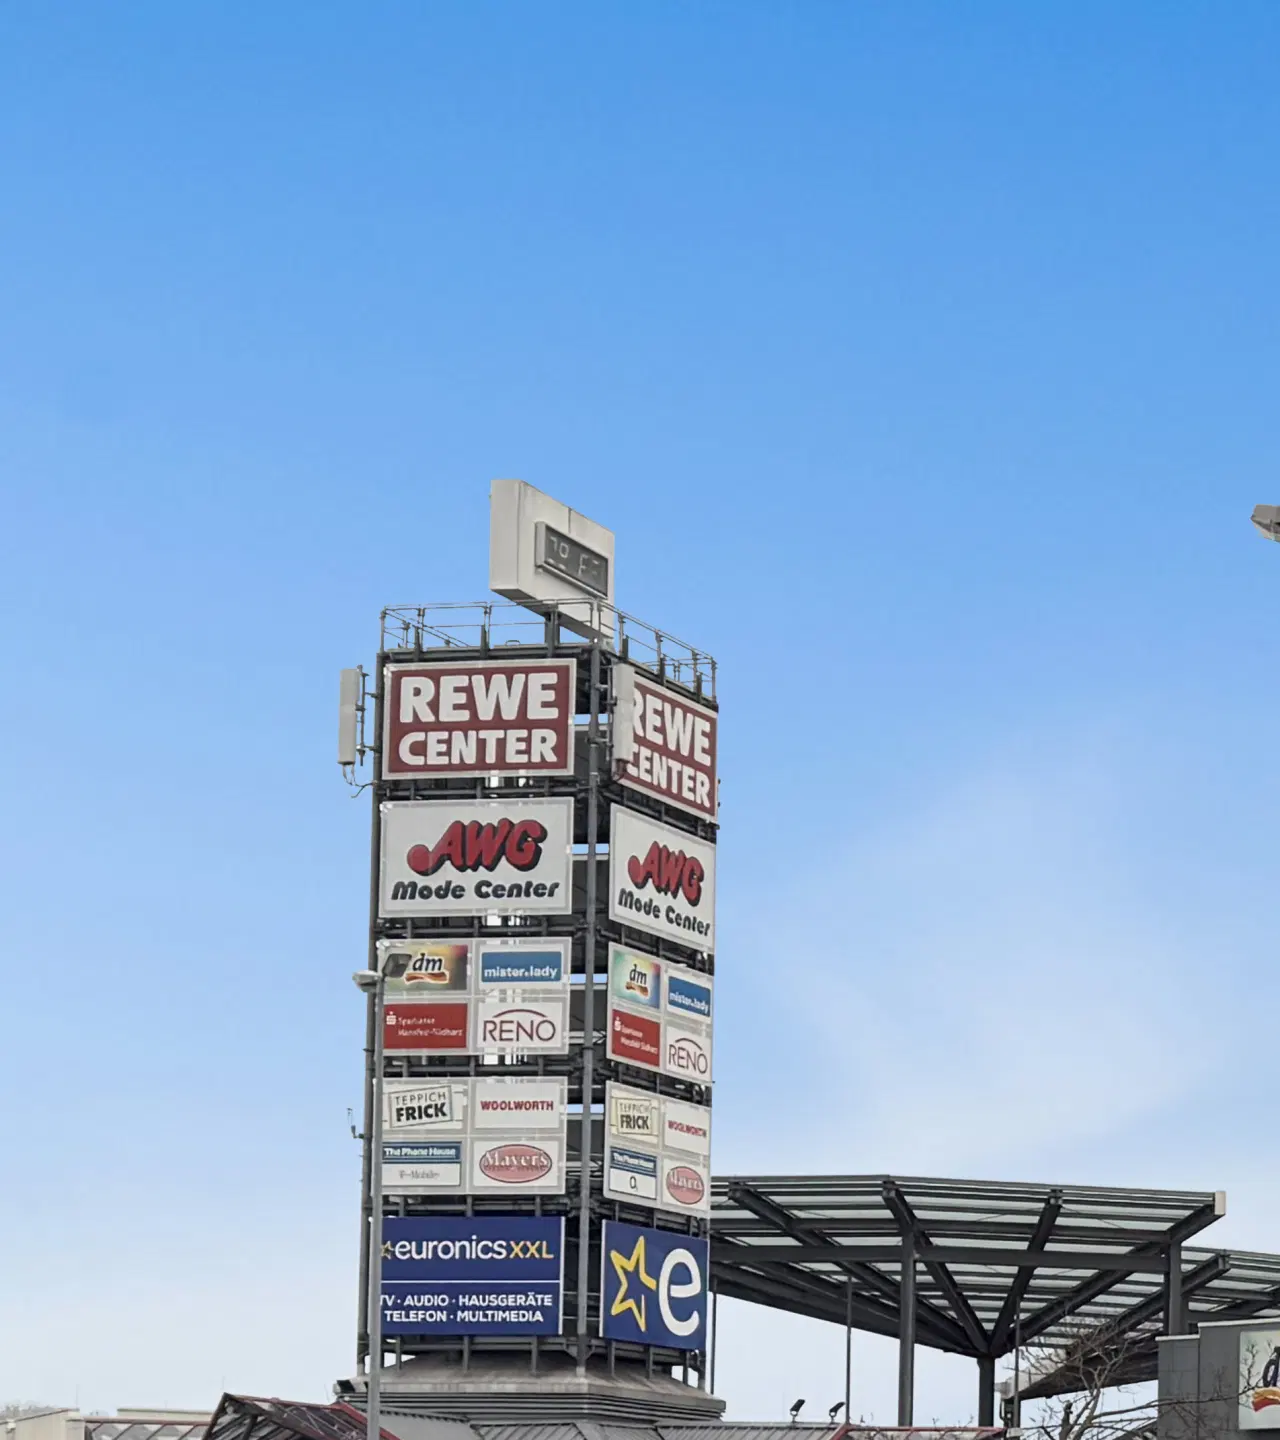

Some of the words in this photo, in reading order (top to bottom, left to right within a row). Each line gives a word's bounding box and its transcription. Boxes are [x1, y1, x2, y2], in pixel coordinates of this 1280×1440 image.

[400, 672, 559, 723] REWE
[399, 729, 557, 765] CENTER
[407, 818, 548, 876] AWG
[628, 841, 704, 907] AWG
[391, 880, 465, 900] Mode
[474, 880, 560, 899] Center
[618, 888, 660, 919] Mode
[665, 905, 711, 936] Center
[412, 952, 443, 972] dm
[484, 965, 558, 979] mister.lady
[630, 963, 647, 985] dm
[483, 1020, 556, 1042] RENO
[668, 1044, 708, 1074] RENO
[395, 1091, 446, 1105] TEPPICH
[480, 1100, 554, 1111] WOOLWORTH
[396, 1102, 447, 1122] FRICK
[620, 1114, 649, 1130] FRICK
[403, 1294, 449, 1306] AUDIO
[458, 1291, 553, 1306] HAUSGERÄTE
[384, 1310, 447, 1322] TELEFON
[456, 1310, 544, 1322] MULTIMEDIA
